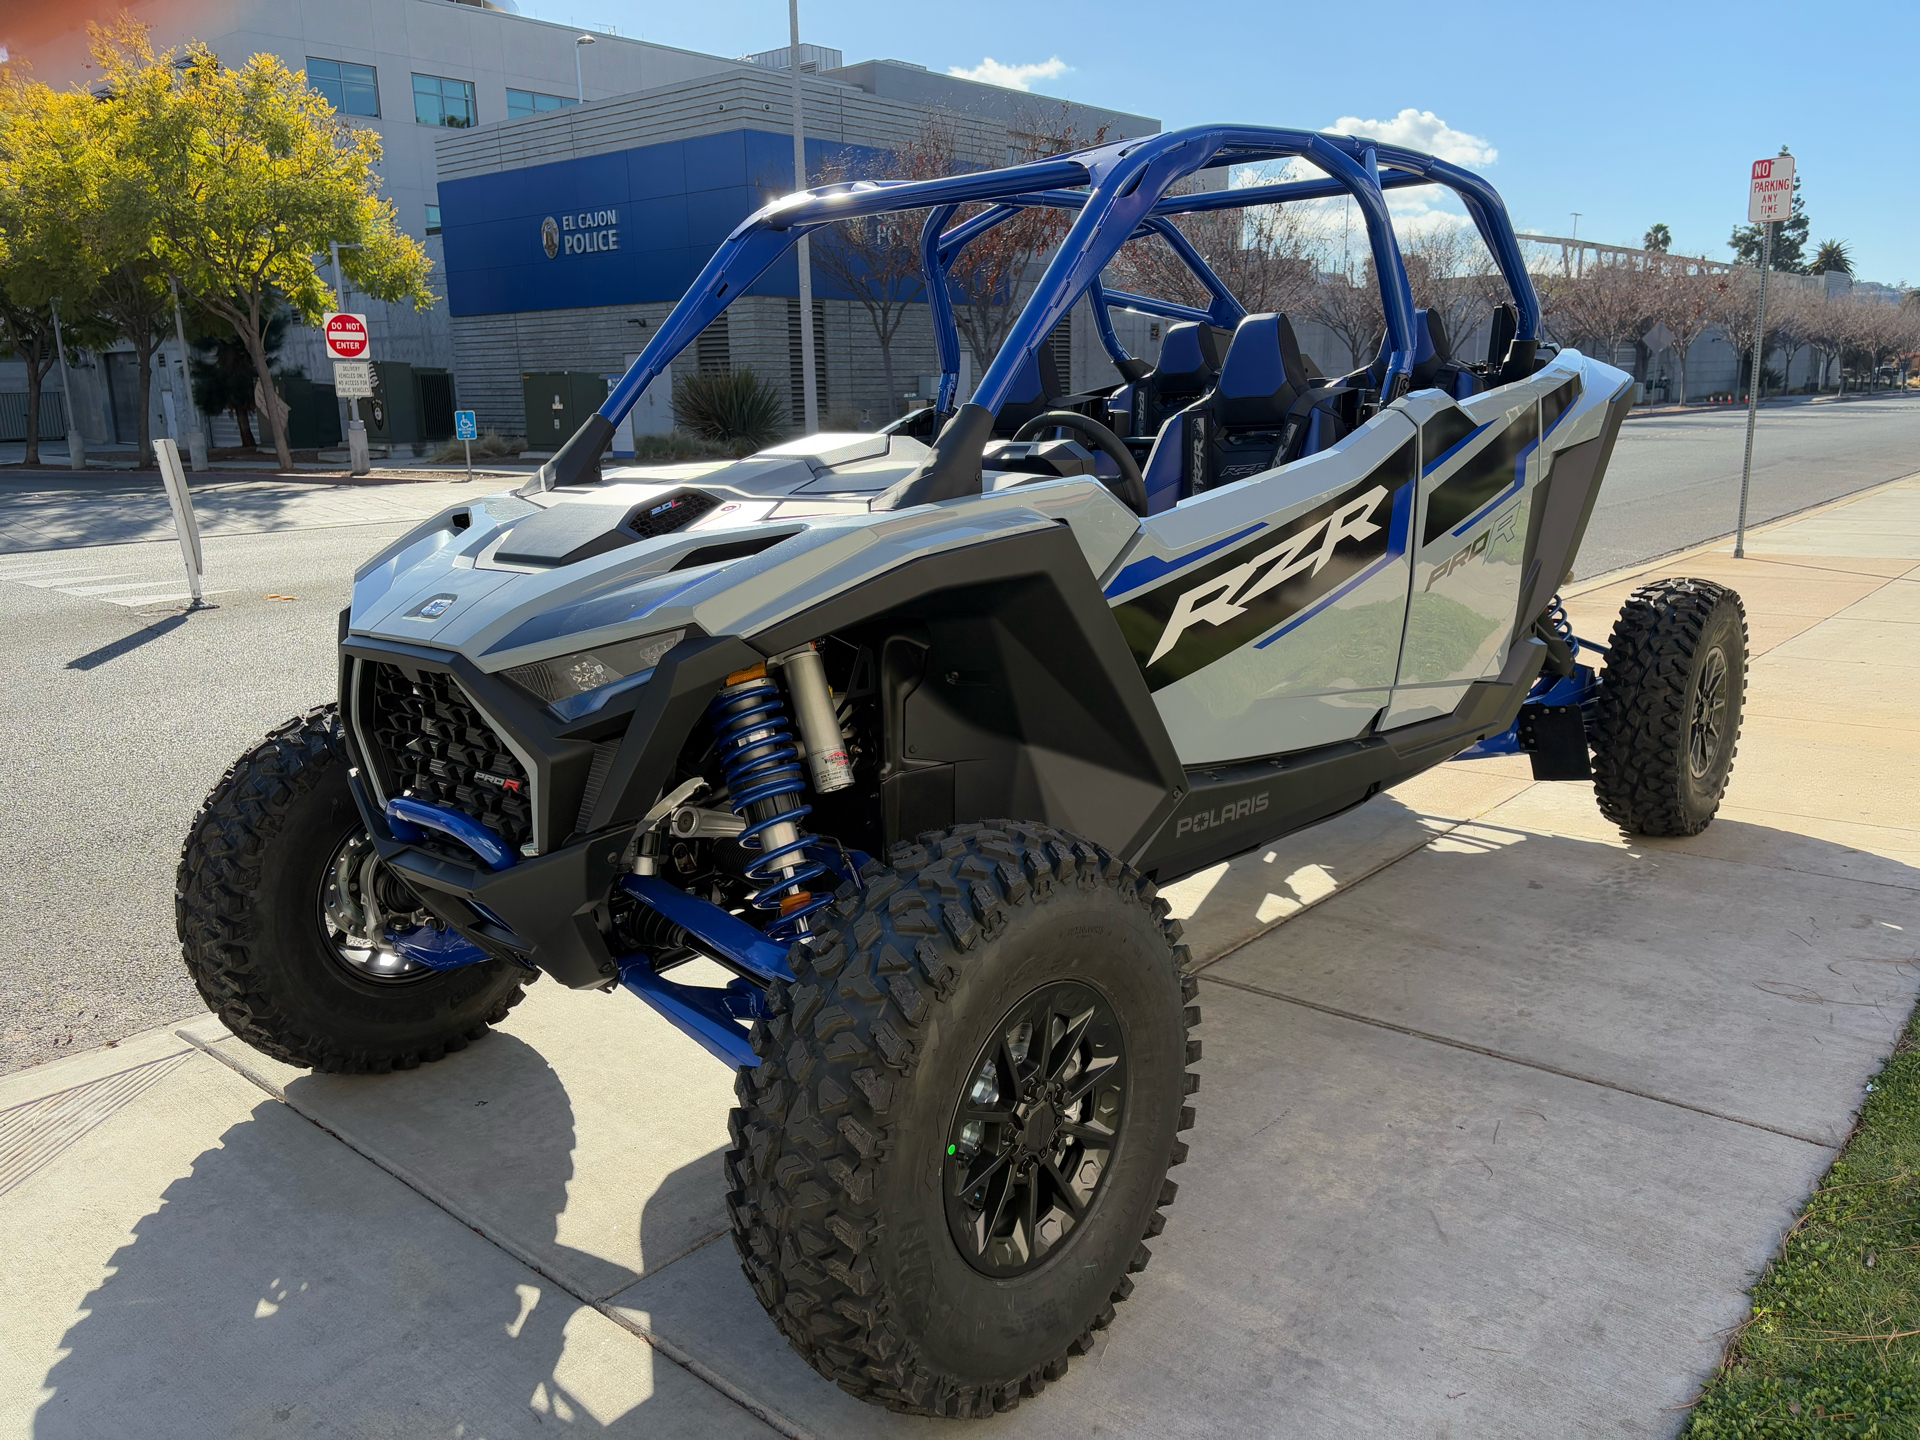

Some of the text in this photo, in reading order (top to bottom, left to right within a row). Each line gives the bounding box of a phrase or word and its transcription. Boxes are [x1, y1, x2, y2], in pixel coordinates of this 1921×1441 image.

[1754, 161, 1770, 178] NO
[1753, 178, 1790, 194] PARKING
[1761, 193, 1779, 204] ANY
[1760, 204, 1778, 215] TIME
[562, 209, 617, 231] EL CAJON
[564, 229, 619, 255] POLICE
[331, 322, 360, 331] DO NOT
[336, 341, 360, 350] ENTER
[1146, 484, 1389, 669] RZR
[1176, 790, 1270, 839] POLARIS
